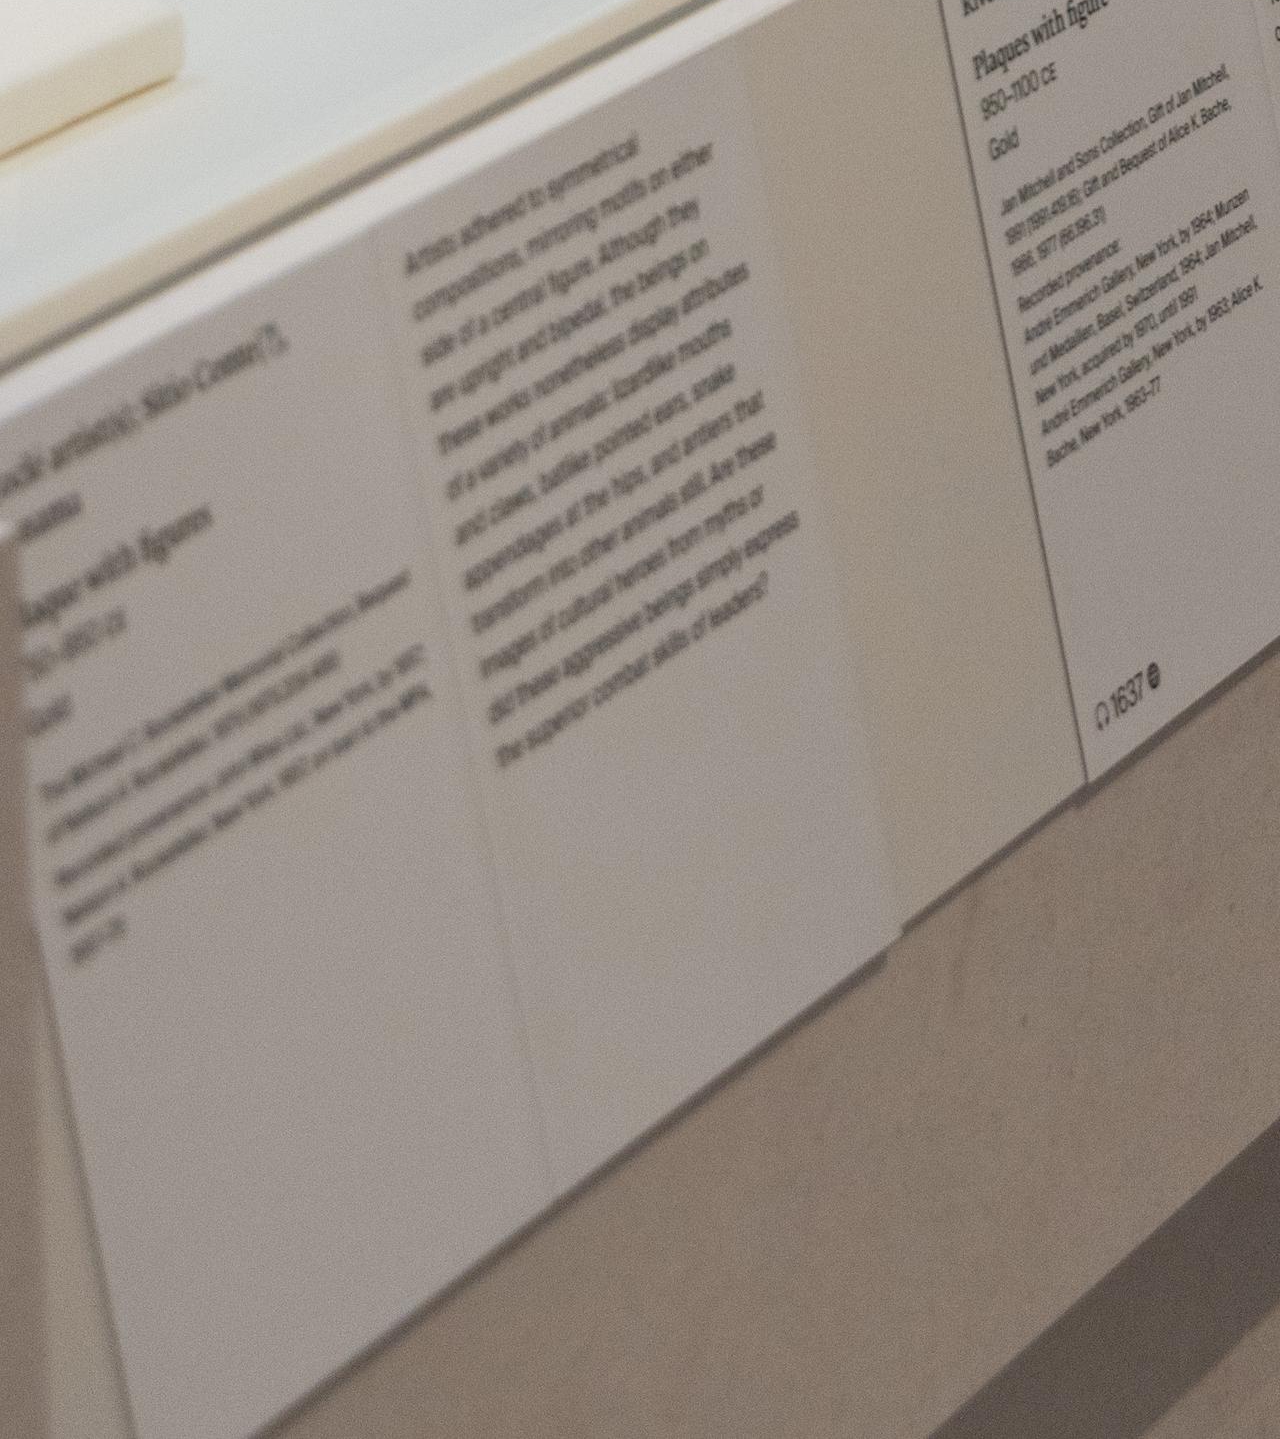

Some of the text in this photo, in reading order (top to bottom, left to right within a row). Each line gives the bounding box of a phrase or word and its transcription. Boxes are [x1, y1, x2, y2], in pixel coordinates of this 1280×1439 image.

[971, 33, 1030, 80] Plaques
[1029, 8, 1066, 45] with
[1039, 61, 1057, 86] CE
[988, 126, 1020, 161] Gold
[1110, 670, 1143, 717] 1637
